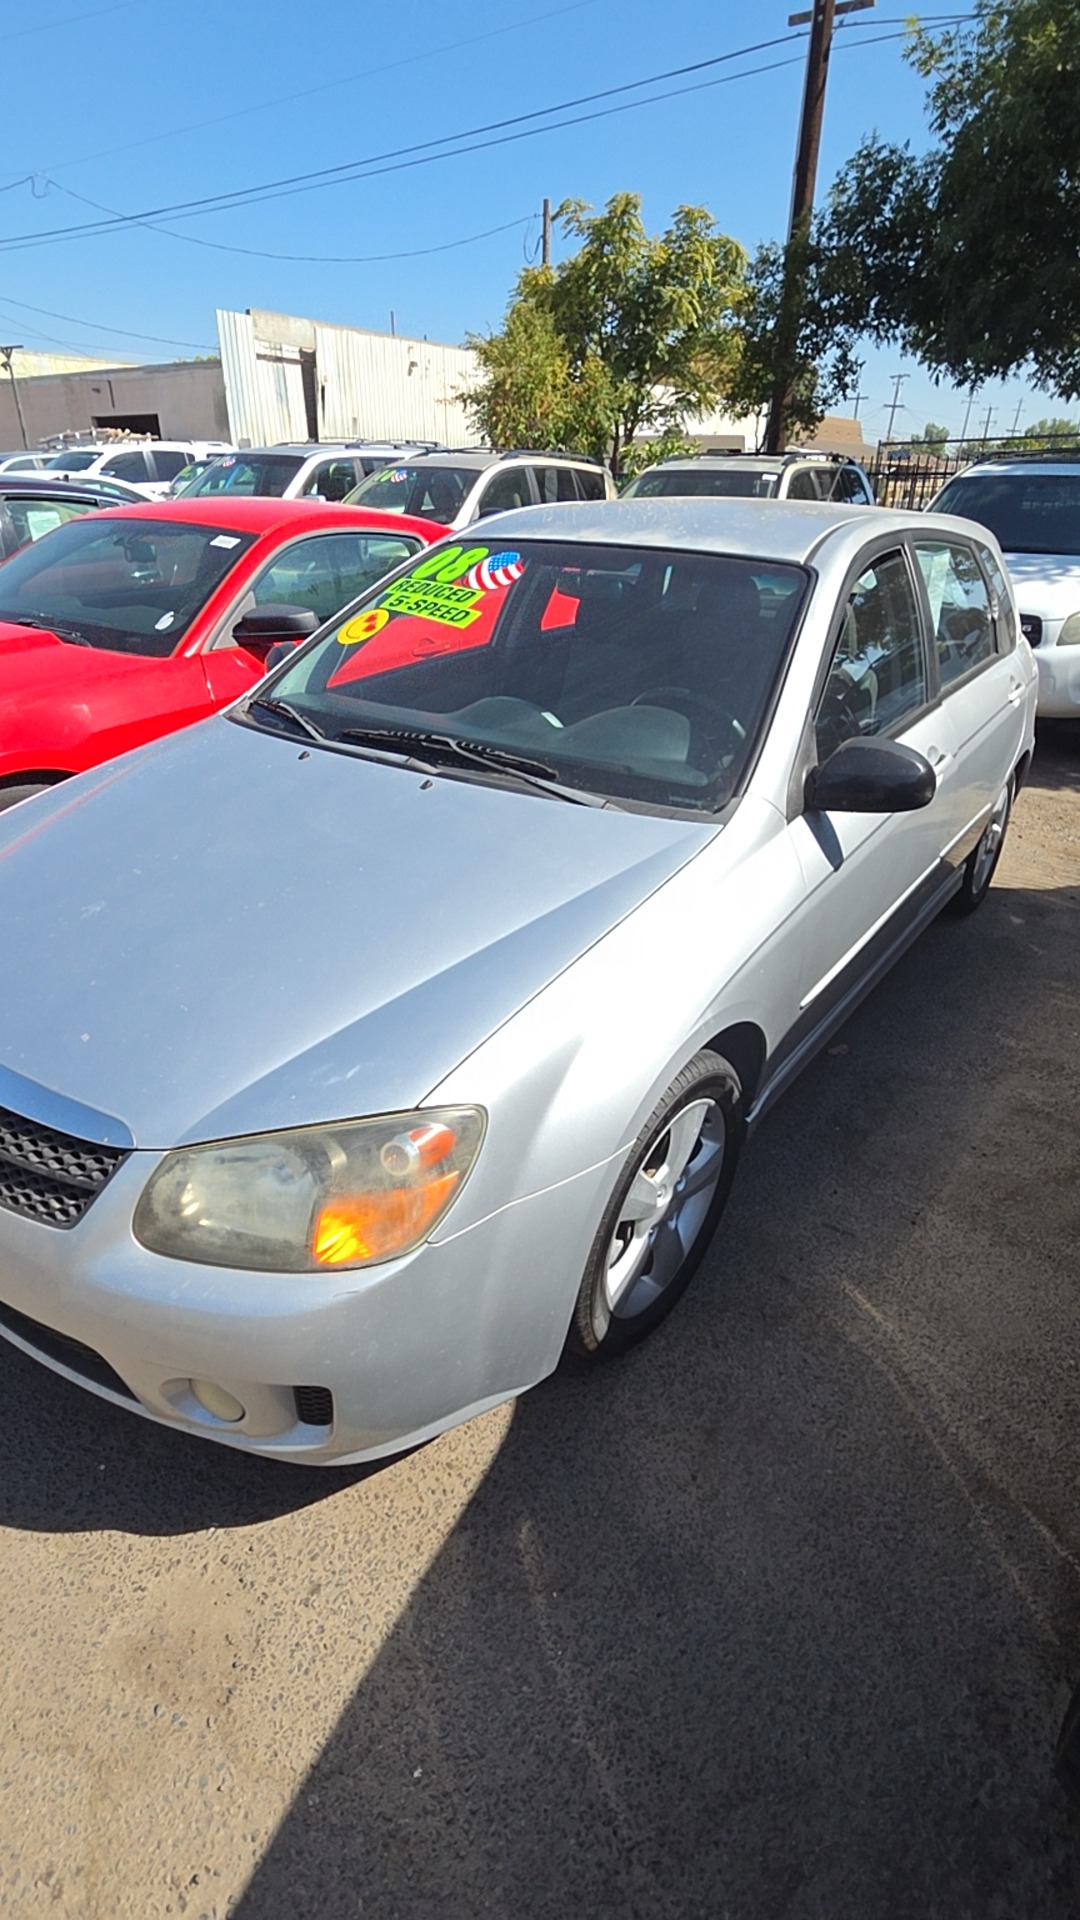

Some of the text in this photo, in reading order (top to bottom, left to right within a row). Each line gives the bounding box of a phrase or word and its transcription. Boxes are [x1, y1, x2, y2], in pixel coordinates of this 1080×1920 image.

[411, 546, 489, 582] 08
[391, 580, 476, 603] REDUCED
[389, 595, 471, 622] 5-SPEED
